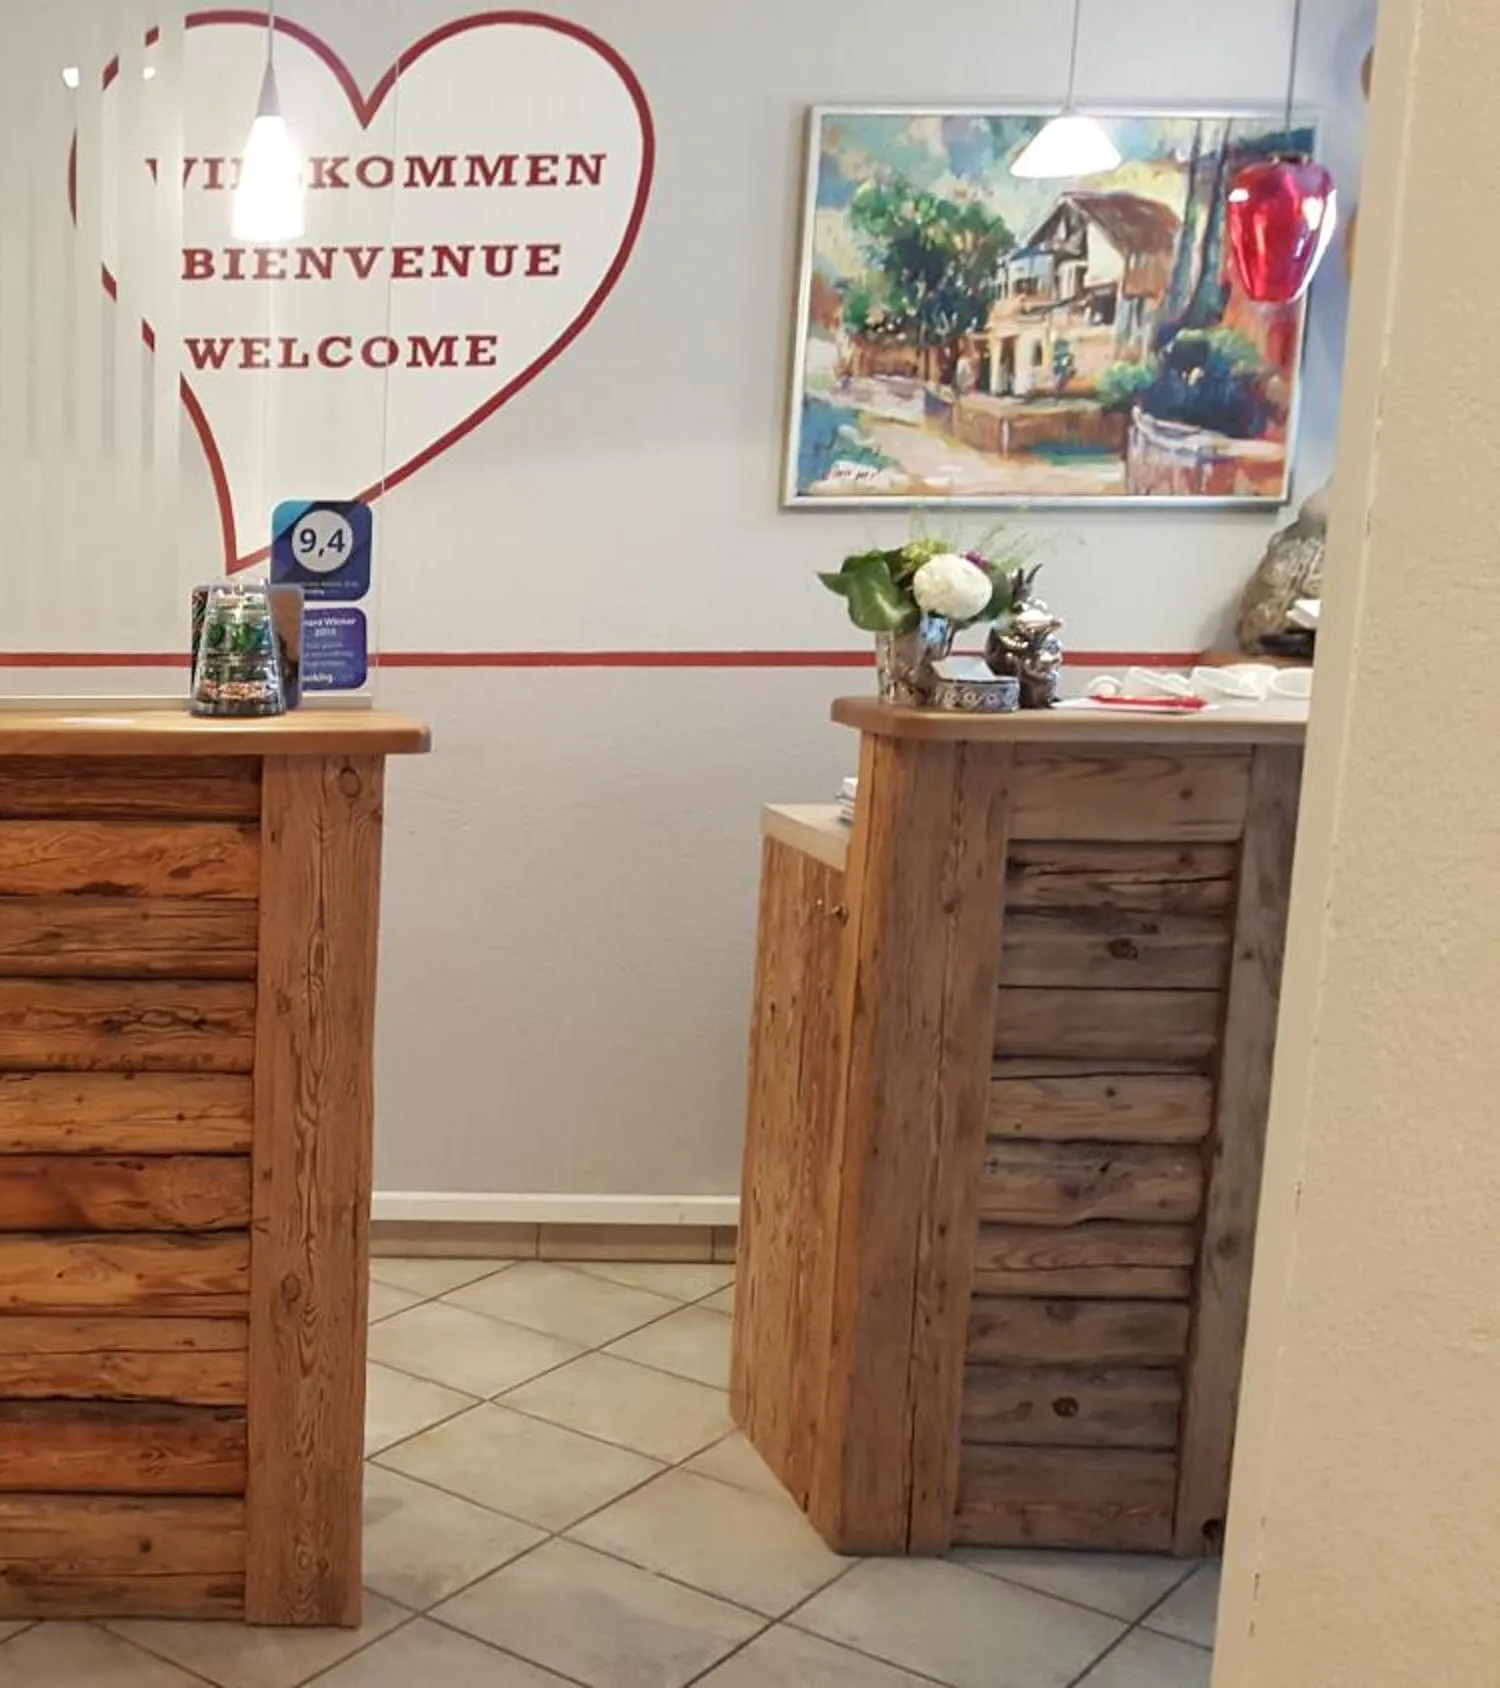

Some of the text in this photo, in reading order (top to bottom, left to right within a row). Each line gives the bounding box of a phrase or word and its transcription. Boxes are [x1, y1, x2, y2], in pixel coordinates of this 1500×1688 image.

[145, 153, 607, 190] IKOMMEN
[181, 243, 561, 281] BIENVENUE
[185, 334, 498, 369] WELCOME
[300, 528, 345, 557] 9,4
